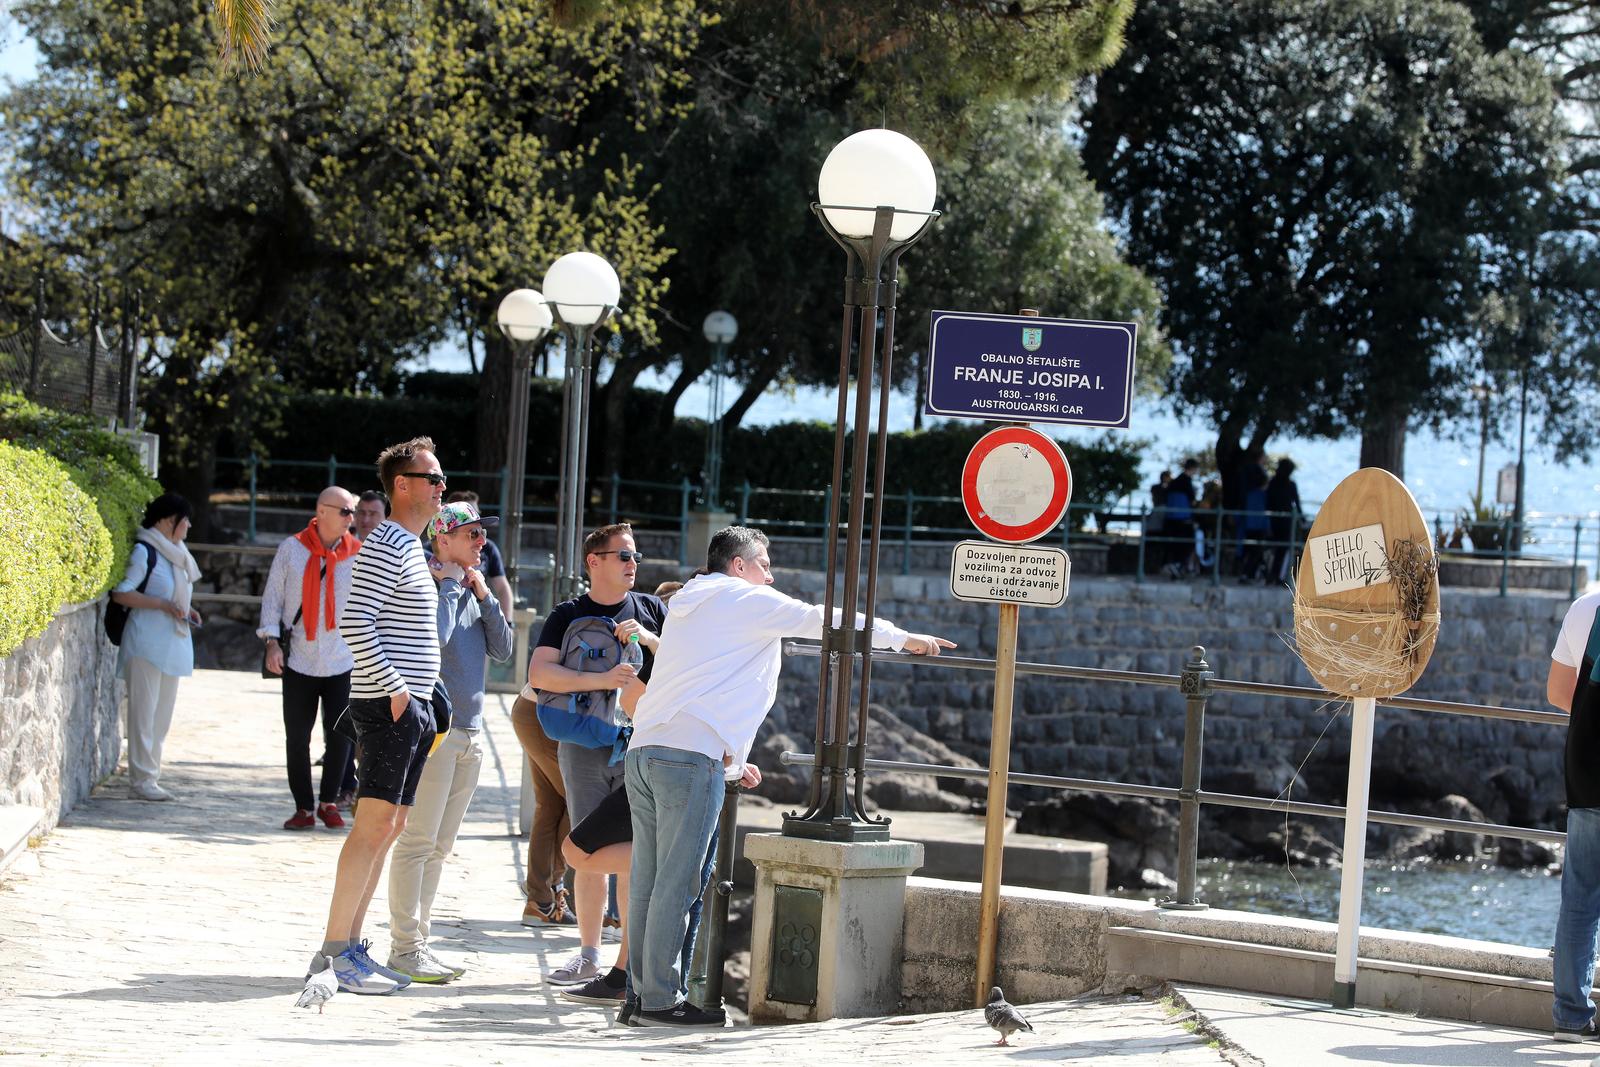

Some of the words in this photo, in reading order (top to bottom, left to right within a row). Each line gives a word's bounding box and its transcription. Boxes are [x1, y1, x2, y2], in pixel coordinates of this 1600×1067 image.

[981, 353, 1024, 364] OBALNO
[1026, 355, 1080, 368] ŠETALIŠTE
[954, 366, 1023, 384] FRANJE
[1028, 372, 1091, 390] JOSIPA
[1095, 376, 1105, 390] I.
[998, 390, 1022, 400] 1830.
[1034, 392, 1058, 402] 1916.
[972, 399, 1060, 412] AUSTROUGARSKI
[1062, 405, 1084, 414] CAR
[1326, 532, 1363, 559] HELLO
[967, 549, 1016, 563] Dozvoljen
[1020, 555, 1056, 566] promet
[964, 562, 1006, 573] vozilima
[1010, 566, 1022, 574] za
[1026, 567, 1056, 578] odvoz
[1324, 551, 1372, 584] SPRING
[960, 574, 992, 584] smeća
[1002, 576, 1060, 591] održavanje
[990, 586, 1028, 598] čistoće
